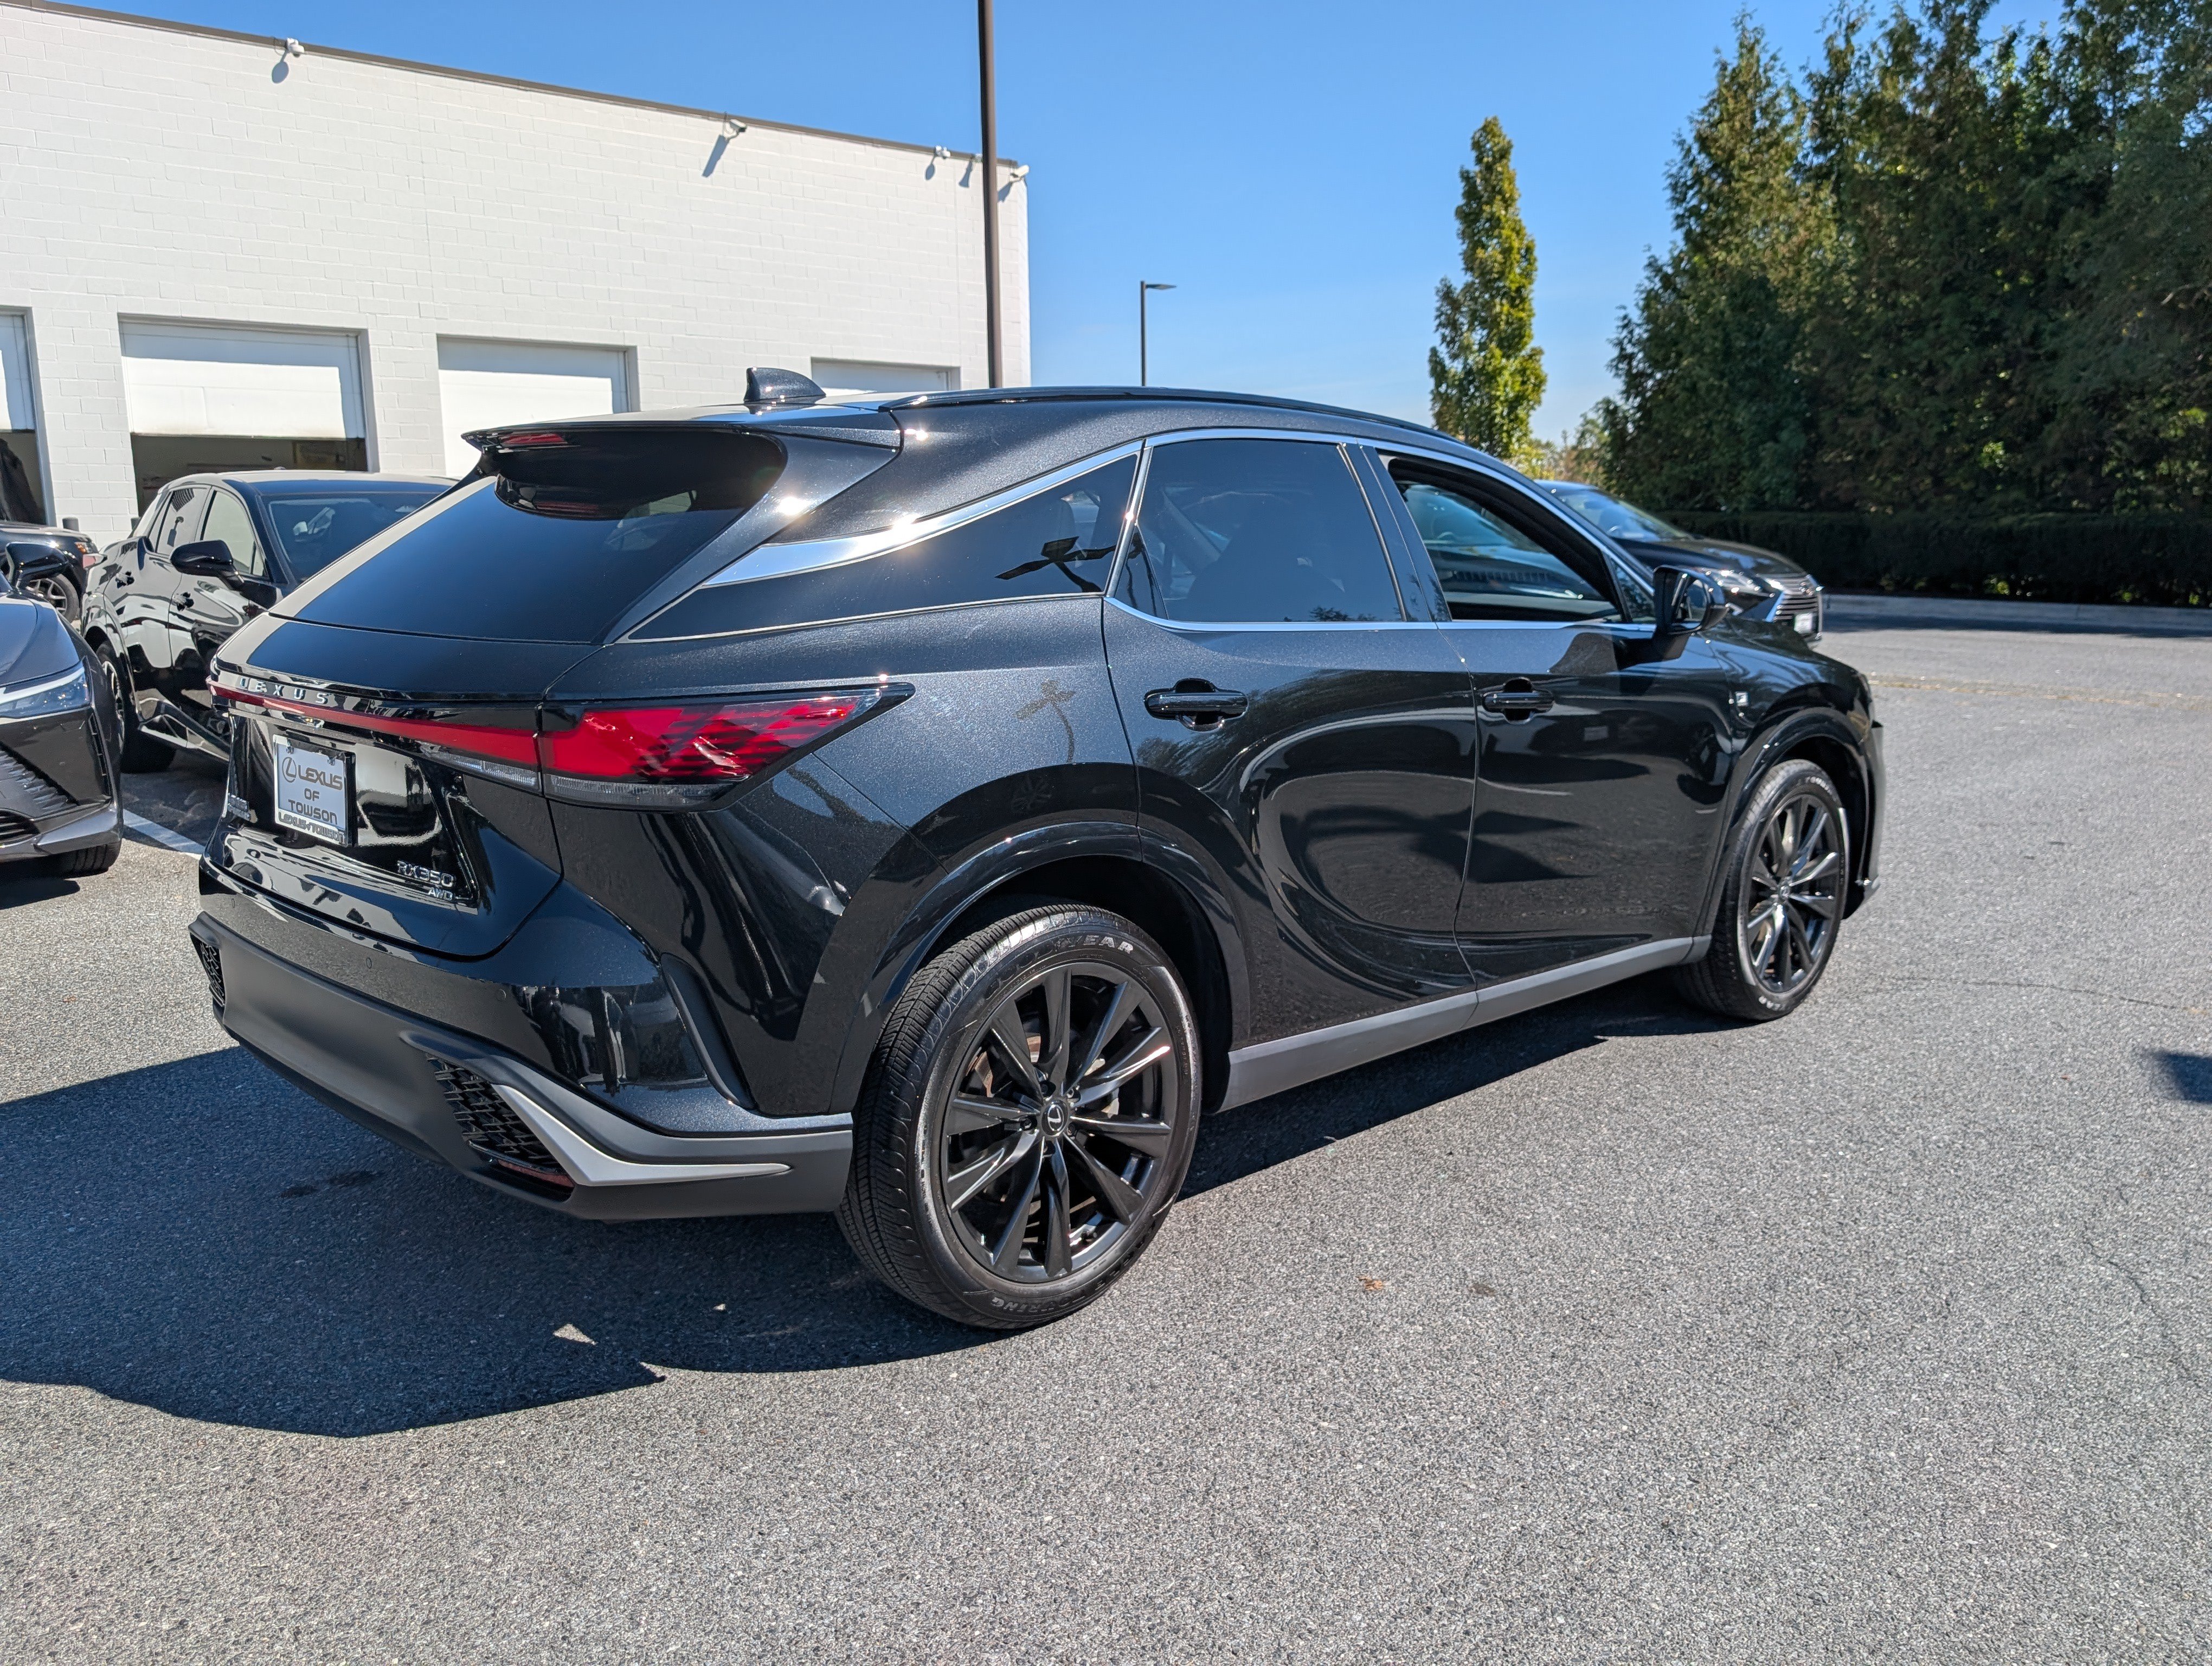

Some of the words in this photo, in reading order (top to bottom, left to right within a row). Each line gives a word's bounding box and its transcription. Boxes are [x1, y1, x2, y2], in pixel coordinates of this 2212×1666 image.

[239, 677, 329, 705] LEXUS
[298, 765, 343, 791] LEXUS
[304, 788, 320, 802] OF
[288, 799, 338, 825] TOWSON
[427, 887, 453, 901] AWD
